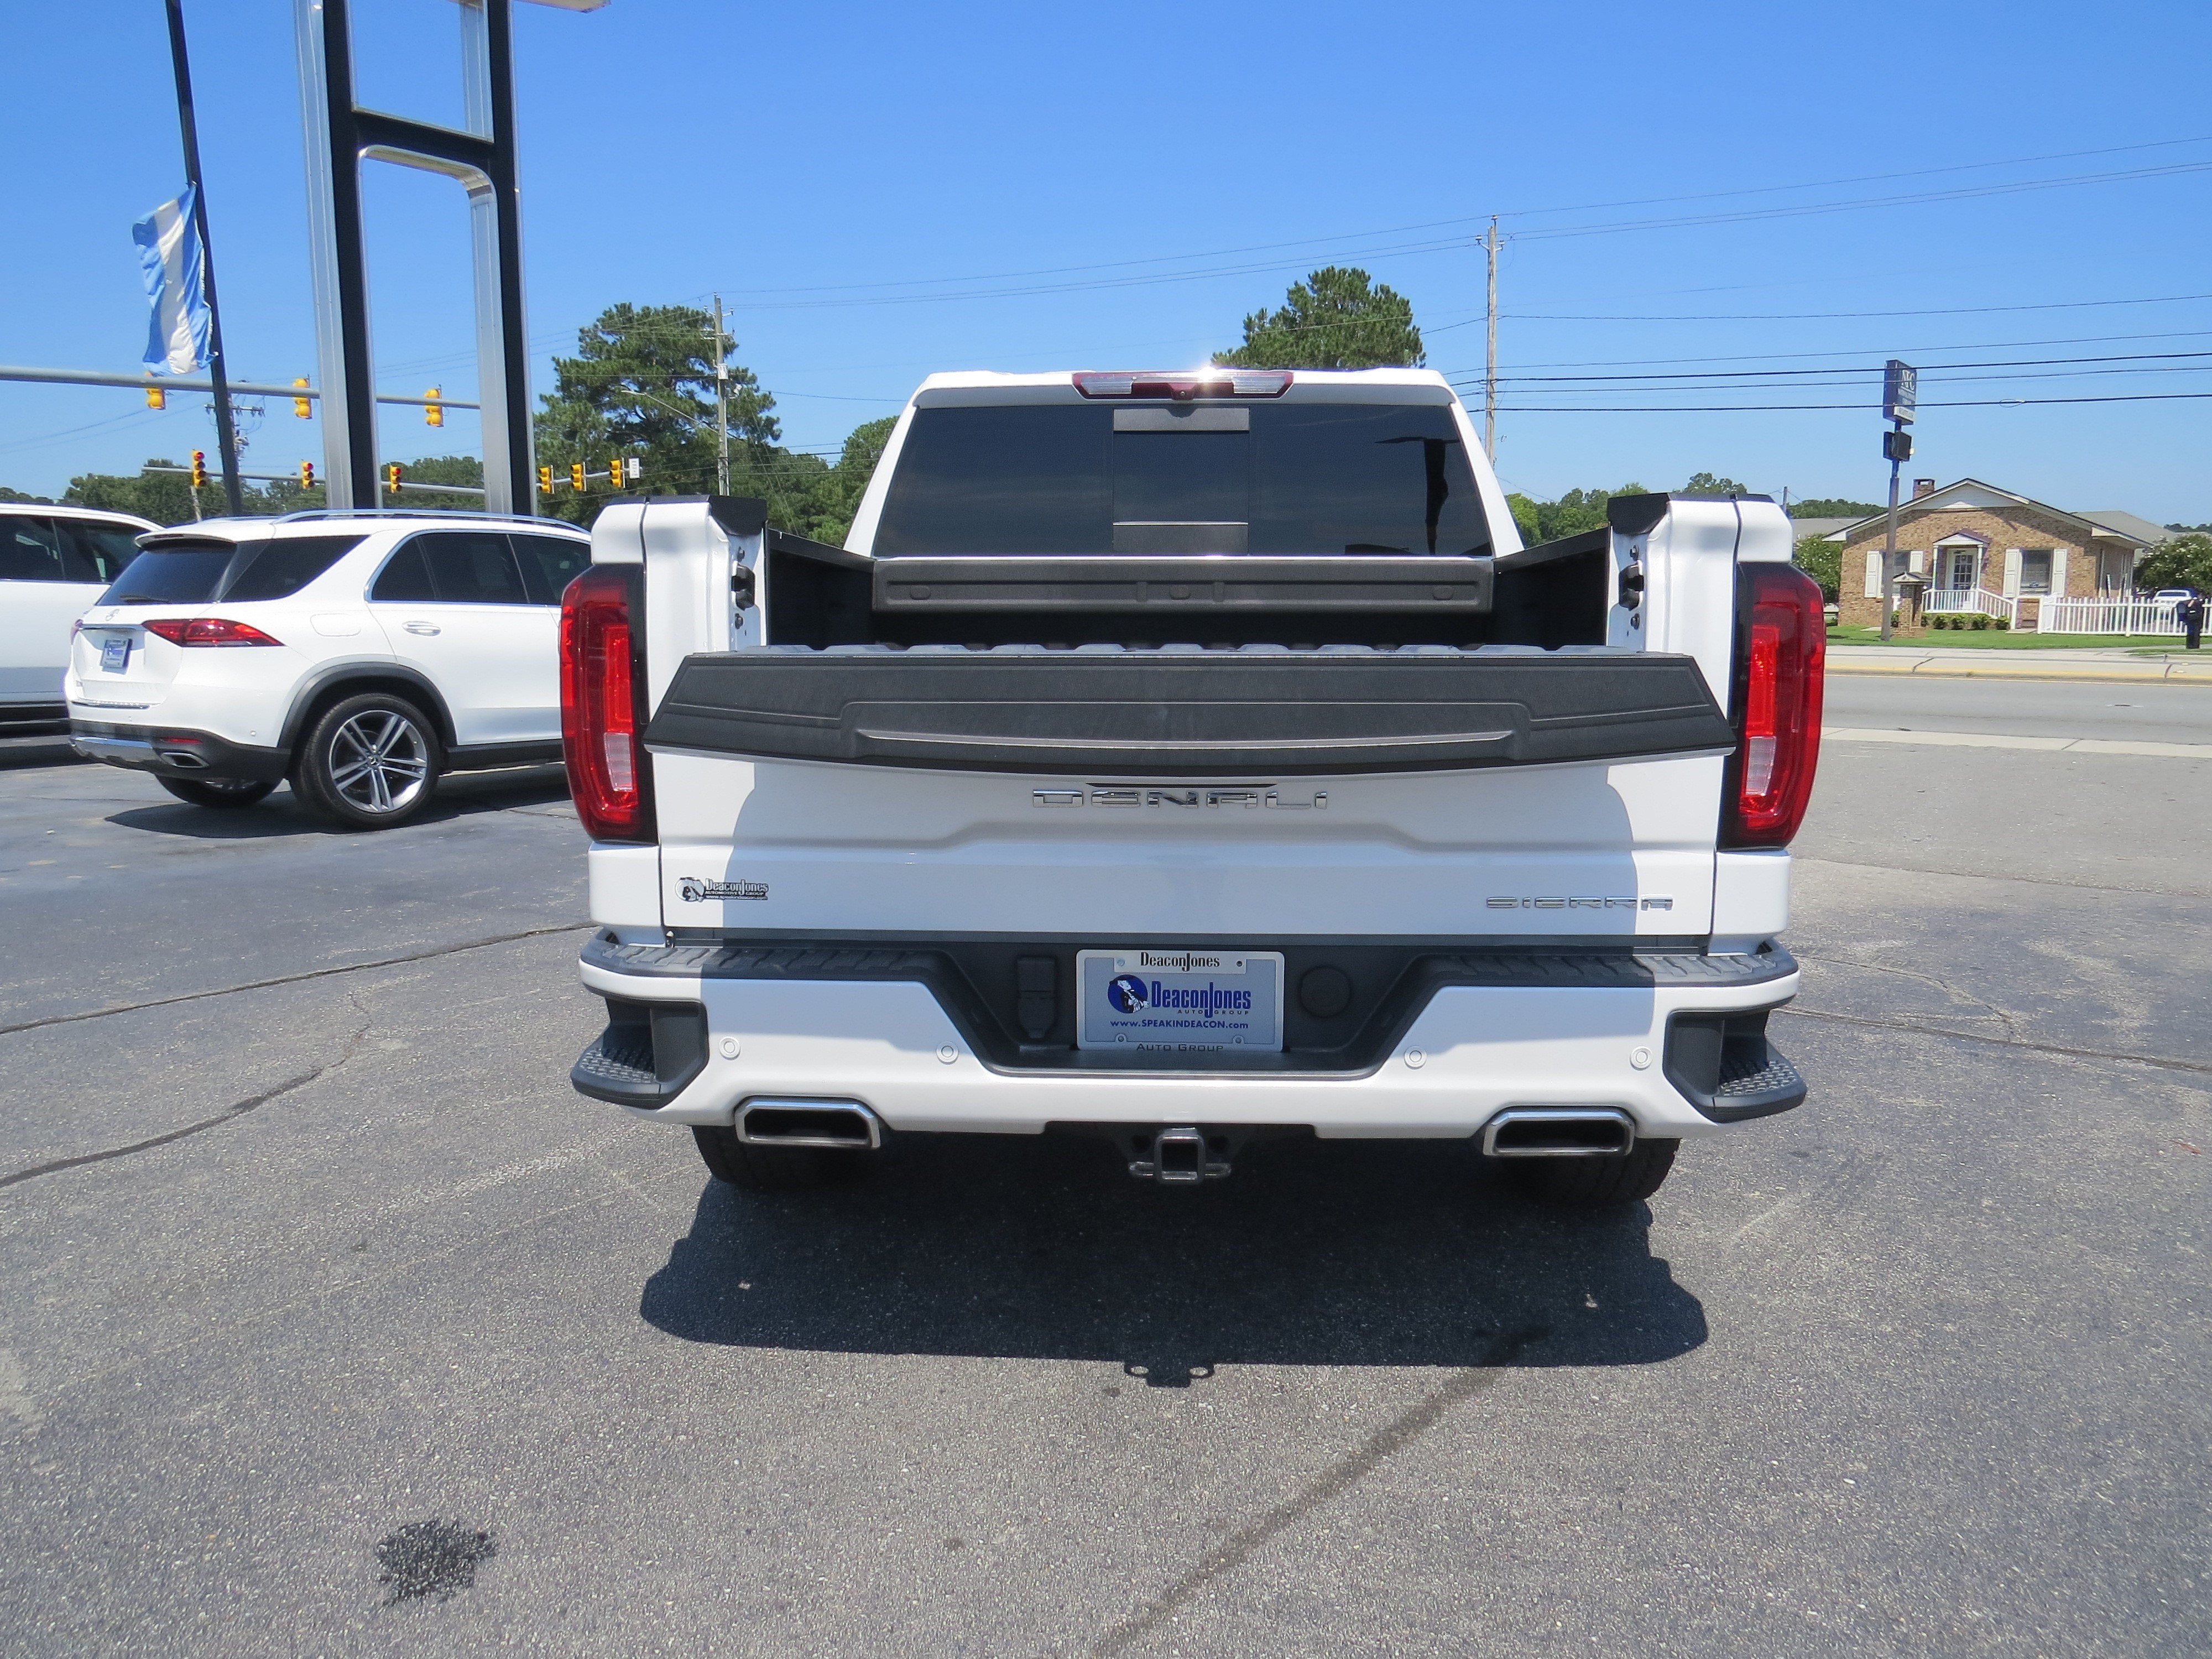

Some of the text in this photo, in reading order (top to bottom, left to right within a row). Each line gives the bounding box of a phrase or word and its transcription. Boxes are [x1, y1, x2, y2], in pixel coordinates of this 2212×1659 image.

[1032, 789, 1327, 809] DENALI
[705, 878, 769, 895] DeaconJones
[1486, 896, 1673, 911] SIERRA
[1140, 951, 1220, 972] DeaconJones
[1151, 981, 1251, 1018] DeaconJones
[1110, 1019, 1249, 1029] www.SPEAKINDEACON.com
